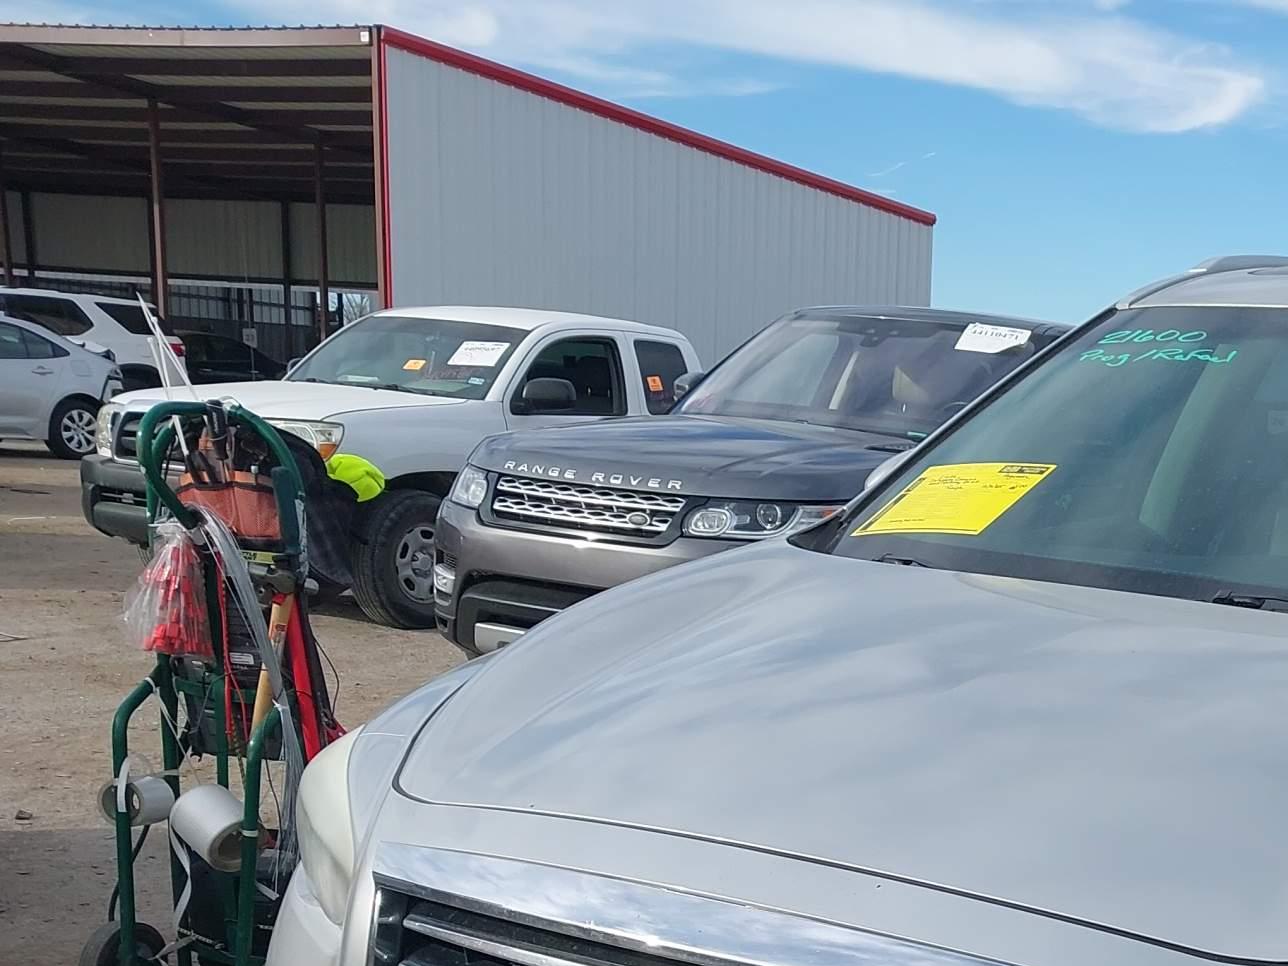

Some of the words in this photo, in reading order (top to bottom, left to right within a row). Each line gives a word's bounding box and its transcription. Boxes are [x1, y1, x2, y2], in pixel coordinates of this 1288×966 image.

[1098, 329, 1207, 344] 21600
[504, 460, 577, 479] RANGE
[592, 472, 682, 490] ROVER
